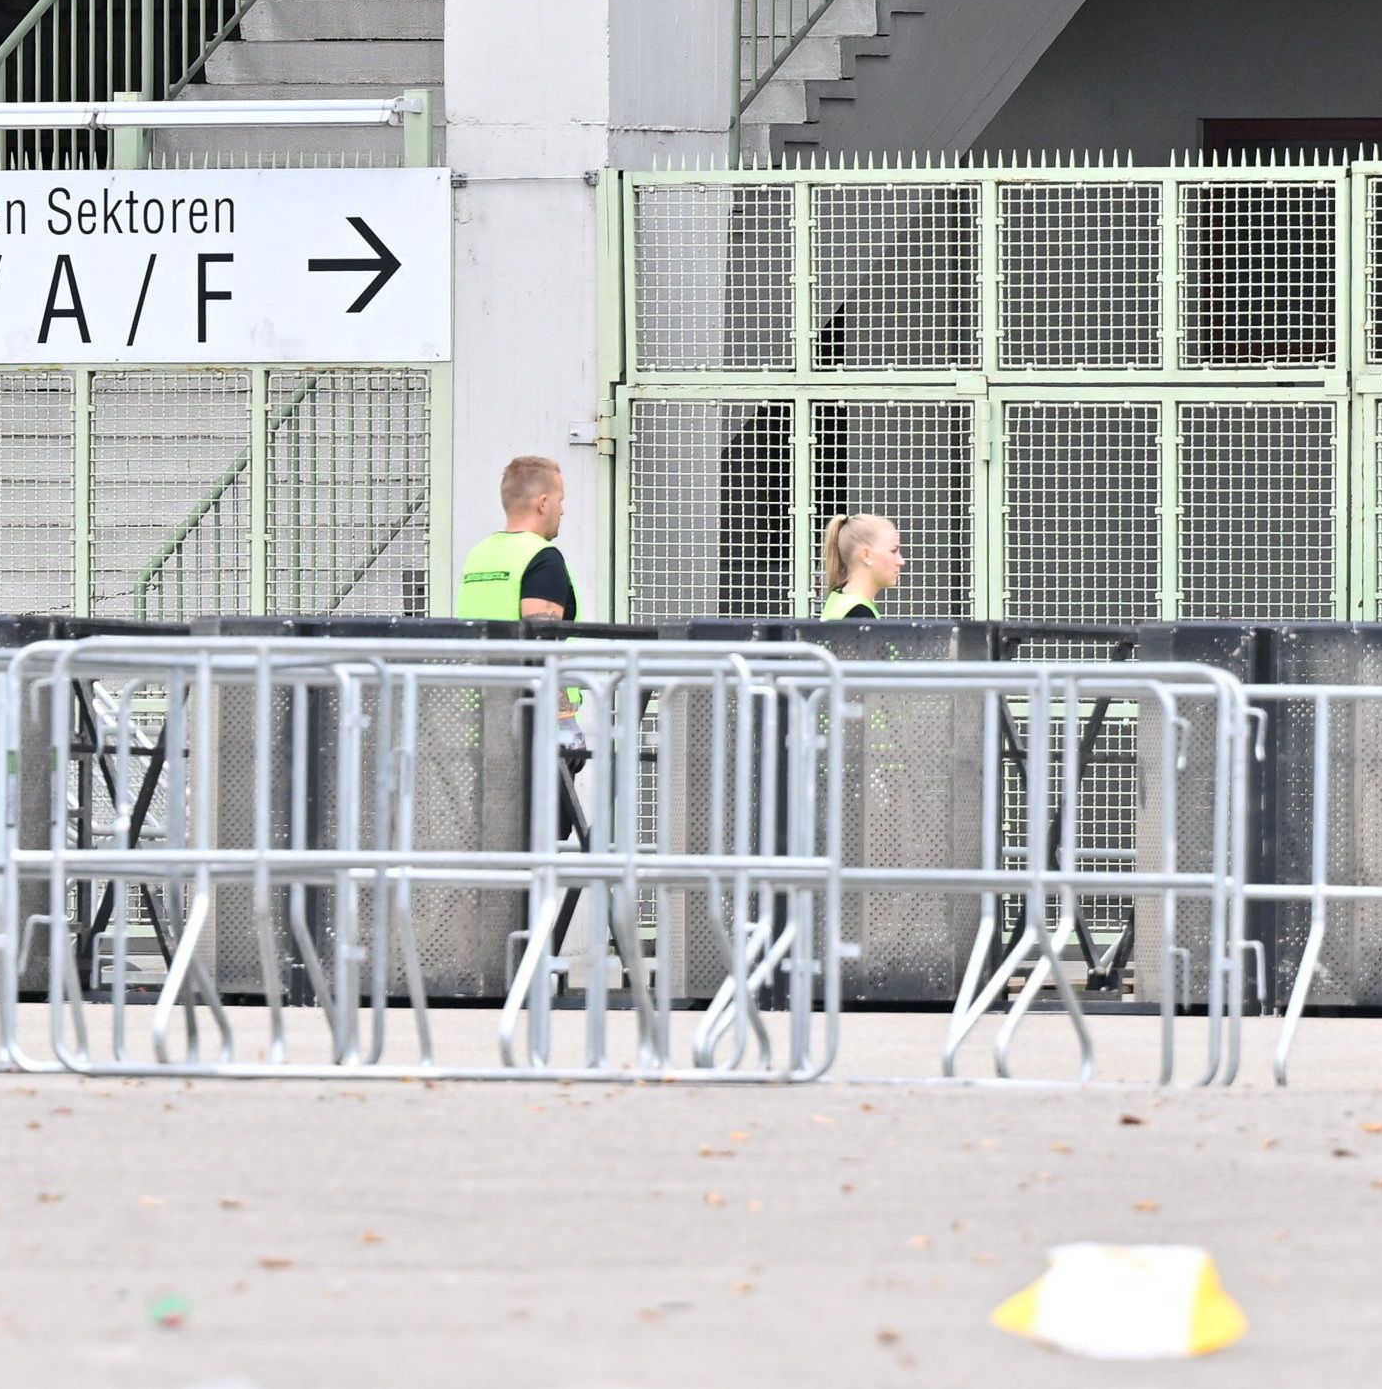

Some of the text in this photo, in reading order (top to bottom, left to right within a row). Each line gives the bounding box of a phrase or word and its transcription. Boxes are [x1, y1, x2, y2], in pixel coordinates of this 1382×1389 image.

[46, 186, 236, 237] Sektoren
[37, 254, 92, 344] A
[197, 252, 234, 344] F
